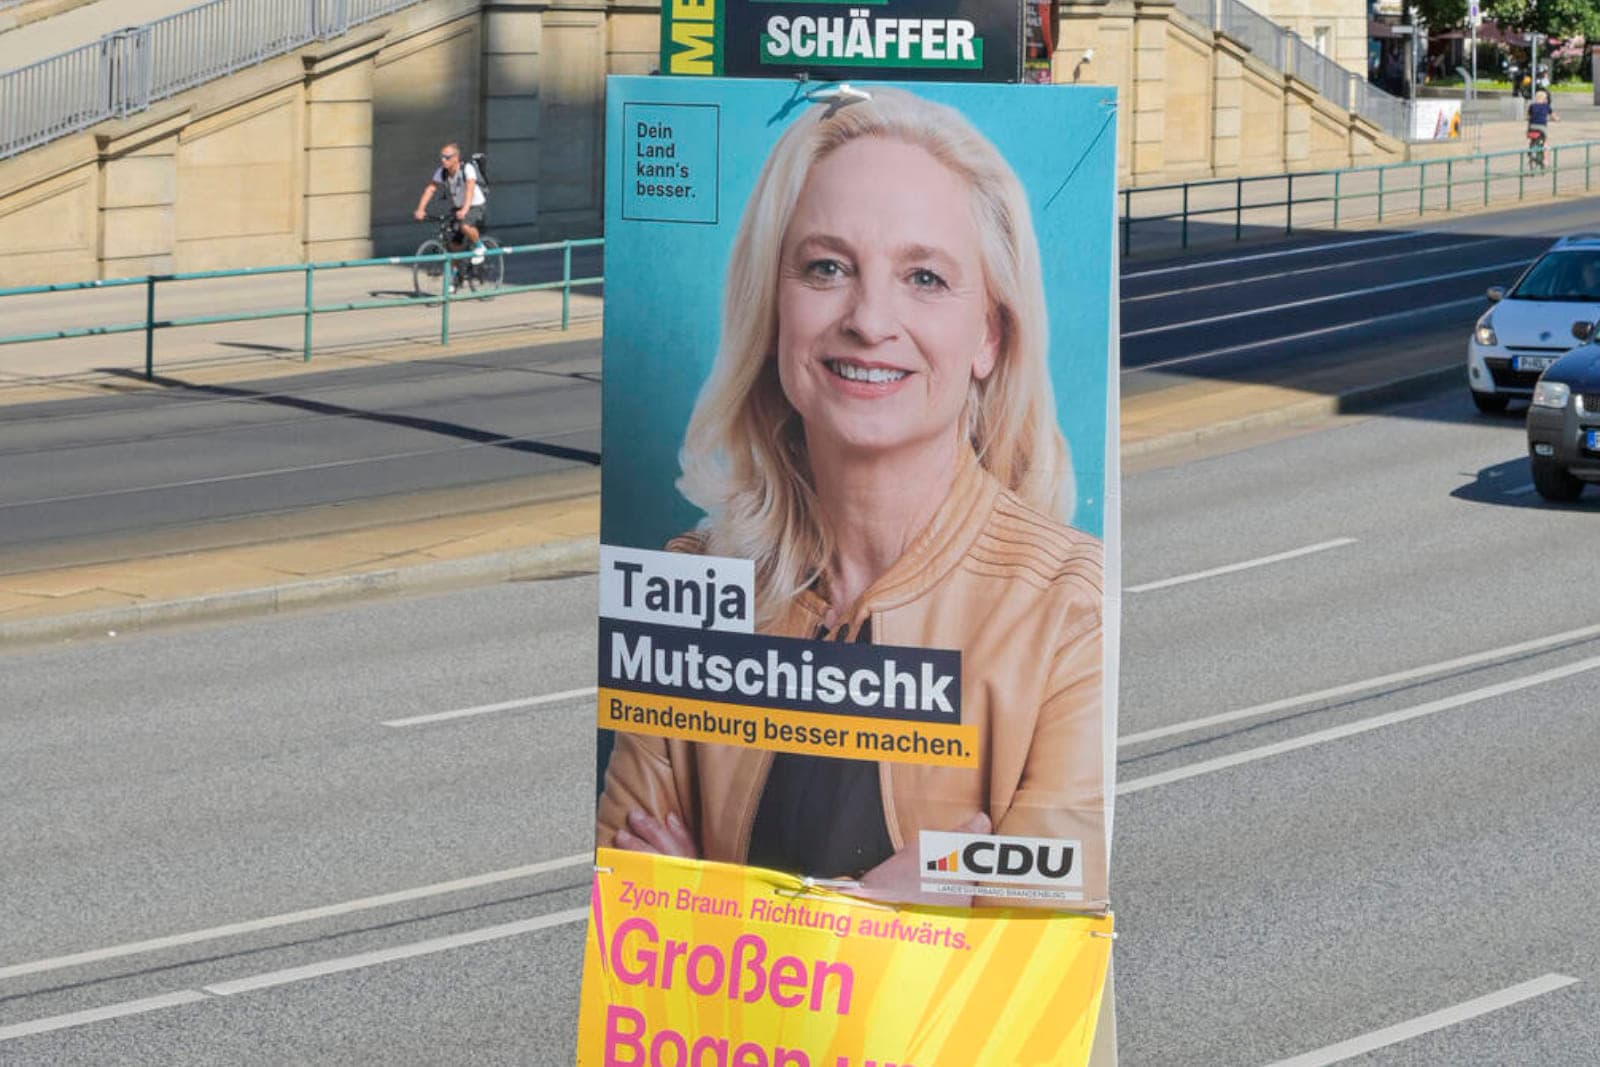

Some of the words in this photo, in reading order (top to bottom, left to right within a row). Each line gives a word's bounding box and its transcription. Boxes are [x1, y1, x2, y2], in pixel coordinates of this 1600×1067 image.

[766, 8, 977, 61] SCHÄFFER
[636, 122, 673, 139] Dein
[636, 142, 676, 158] Land
[636, 180, 696, 198] besser.
[613, 560, 746, 628] Tanja
[611, 631, 954, 713] Mutschischk
[609, 698, 758, 744] Brandenburg
[763, 717, 849, 747] besser
[855, 730, 971, 758] machen.
[962, 841, 1075, 878] CDU
[619, 880, 670, 911] Zyon
[675, 888, 743, 919] Braun.
[749, 898, 852, 938] Richtung
[857, 917, 971, 951] aufwärts.
[611, 917, 855, 1016] Großen
